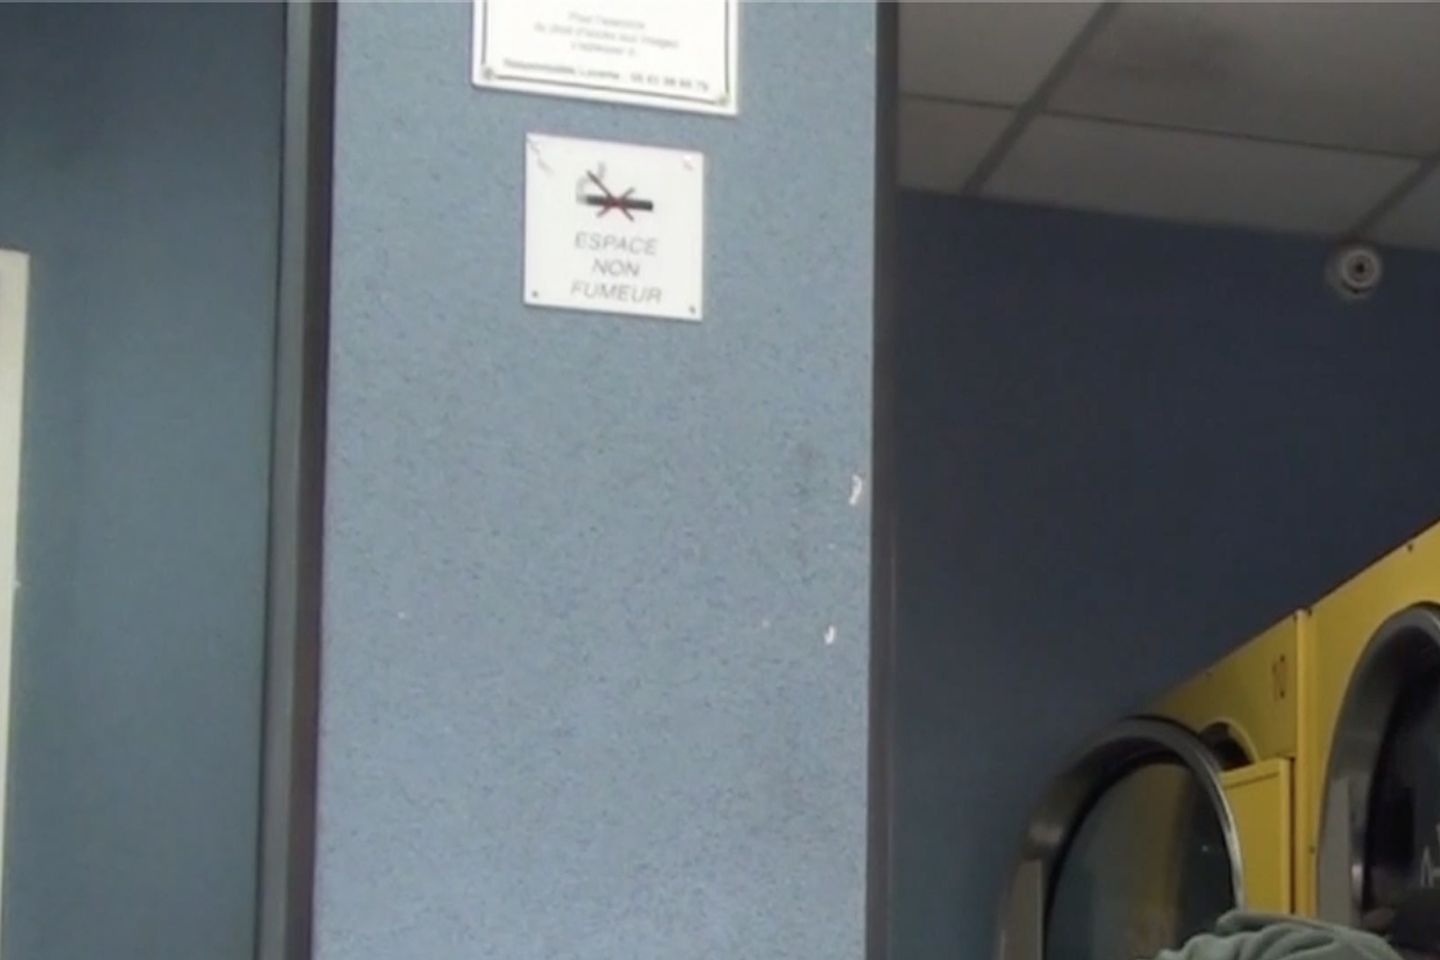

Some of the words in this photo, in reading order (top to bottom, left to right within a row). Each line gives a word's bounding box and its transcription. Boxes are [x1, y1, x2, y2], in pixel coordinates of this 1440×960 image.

[574, 231, 659, 257] ESPACE
[592, 257, 641, 277] NON
[570, 280, 663, 304] FUMEUR
